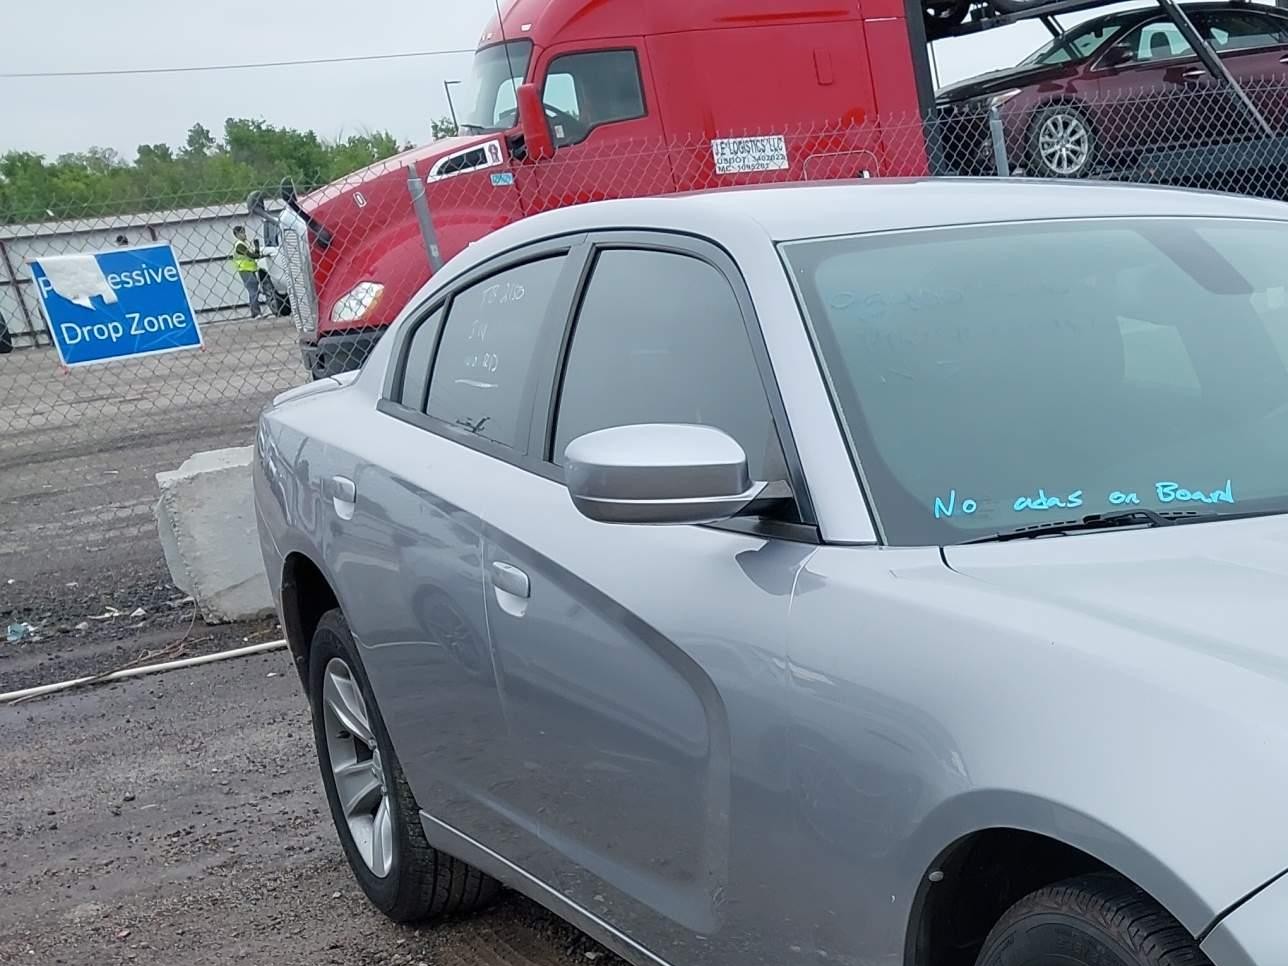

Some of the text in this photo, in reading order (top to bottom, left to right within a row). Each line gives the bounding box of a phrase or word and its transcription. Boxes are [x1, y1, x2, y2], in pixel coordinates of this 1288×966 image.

[728, 139, 766, 155] LOGISTICS
[38, 264, 179, 299] Pessive
[60, 312, 187, 345] Drop Zone
[933, 479, 1235, 519] No adas on Board
